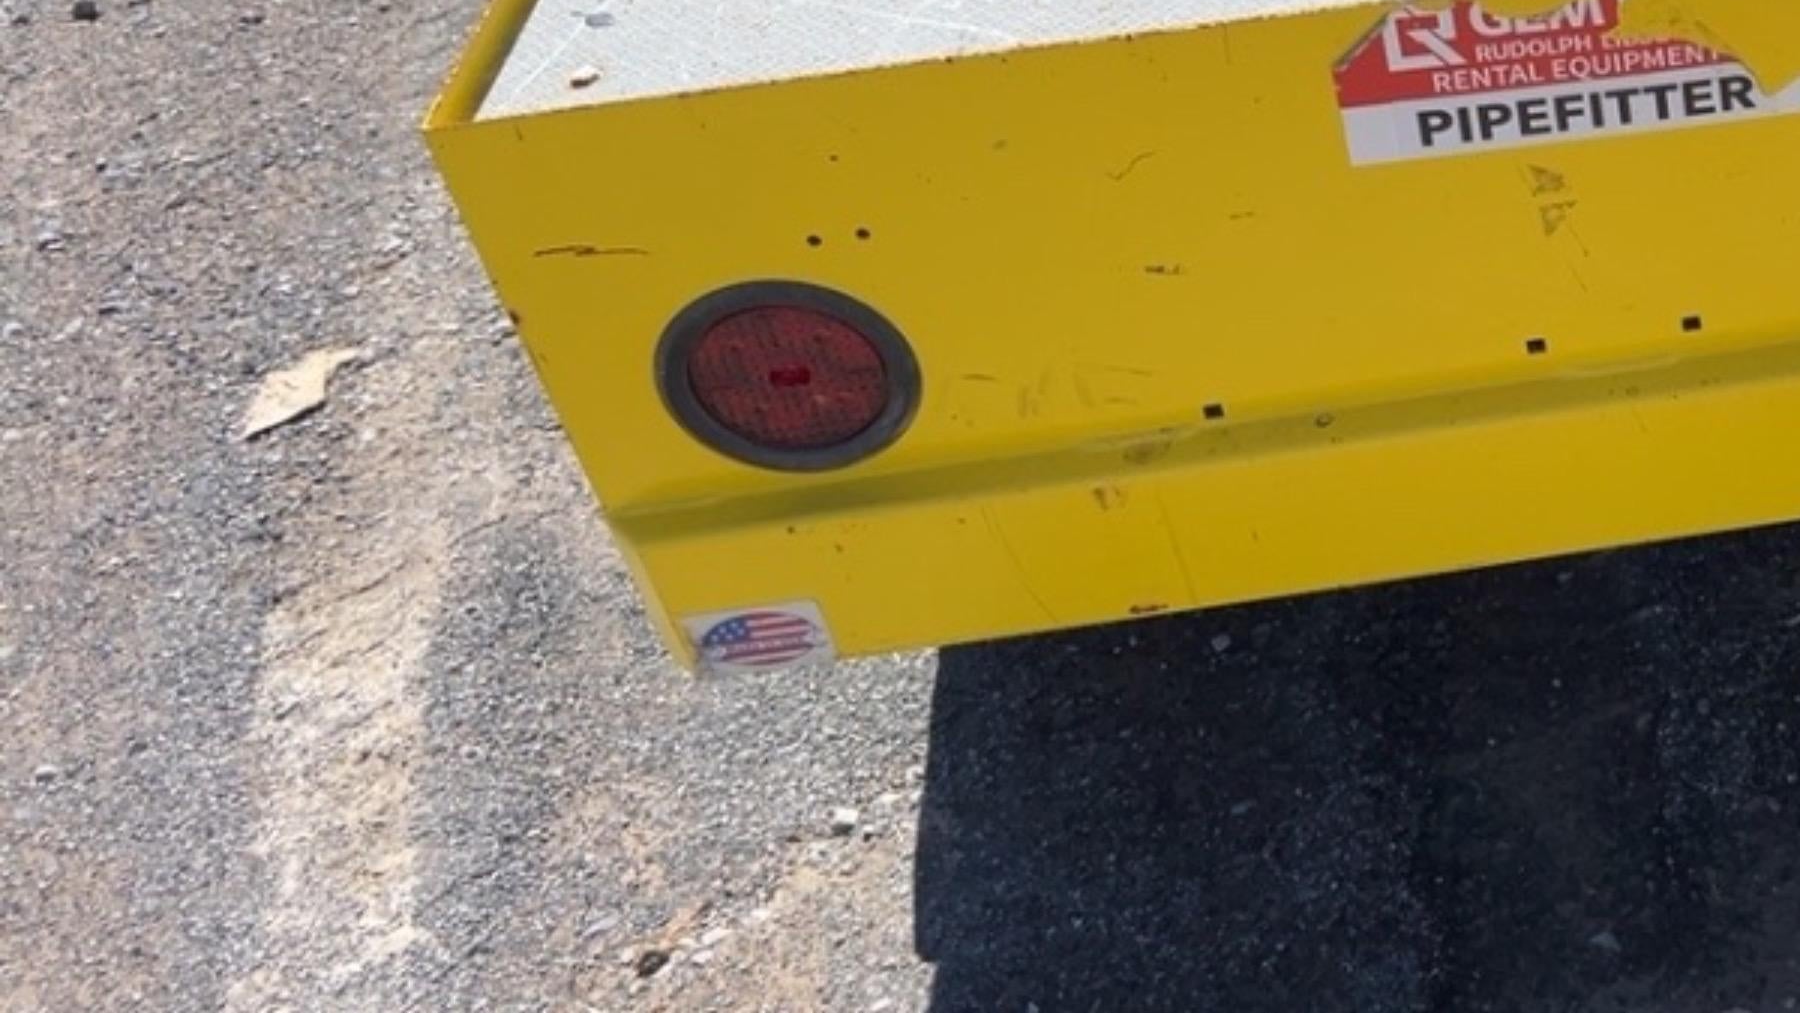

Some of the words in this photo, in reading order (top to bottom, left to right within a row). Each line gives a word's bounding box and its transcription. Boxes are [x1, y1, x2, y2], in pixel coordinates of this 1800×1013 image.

[1475, 36, 1593, 64] RUDOLPH
[1432, 63, 1545, 93] RENTAL
[1416, 74, 1757, 147] PIPEFITTER
